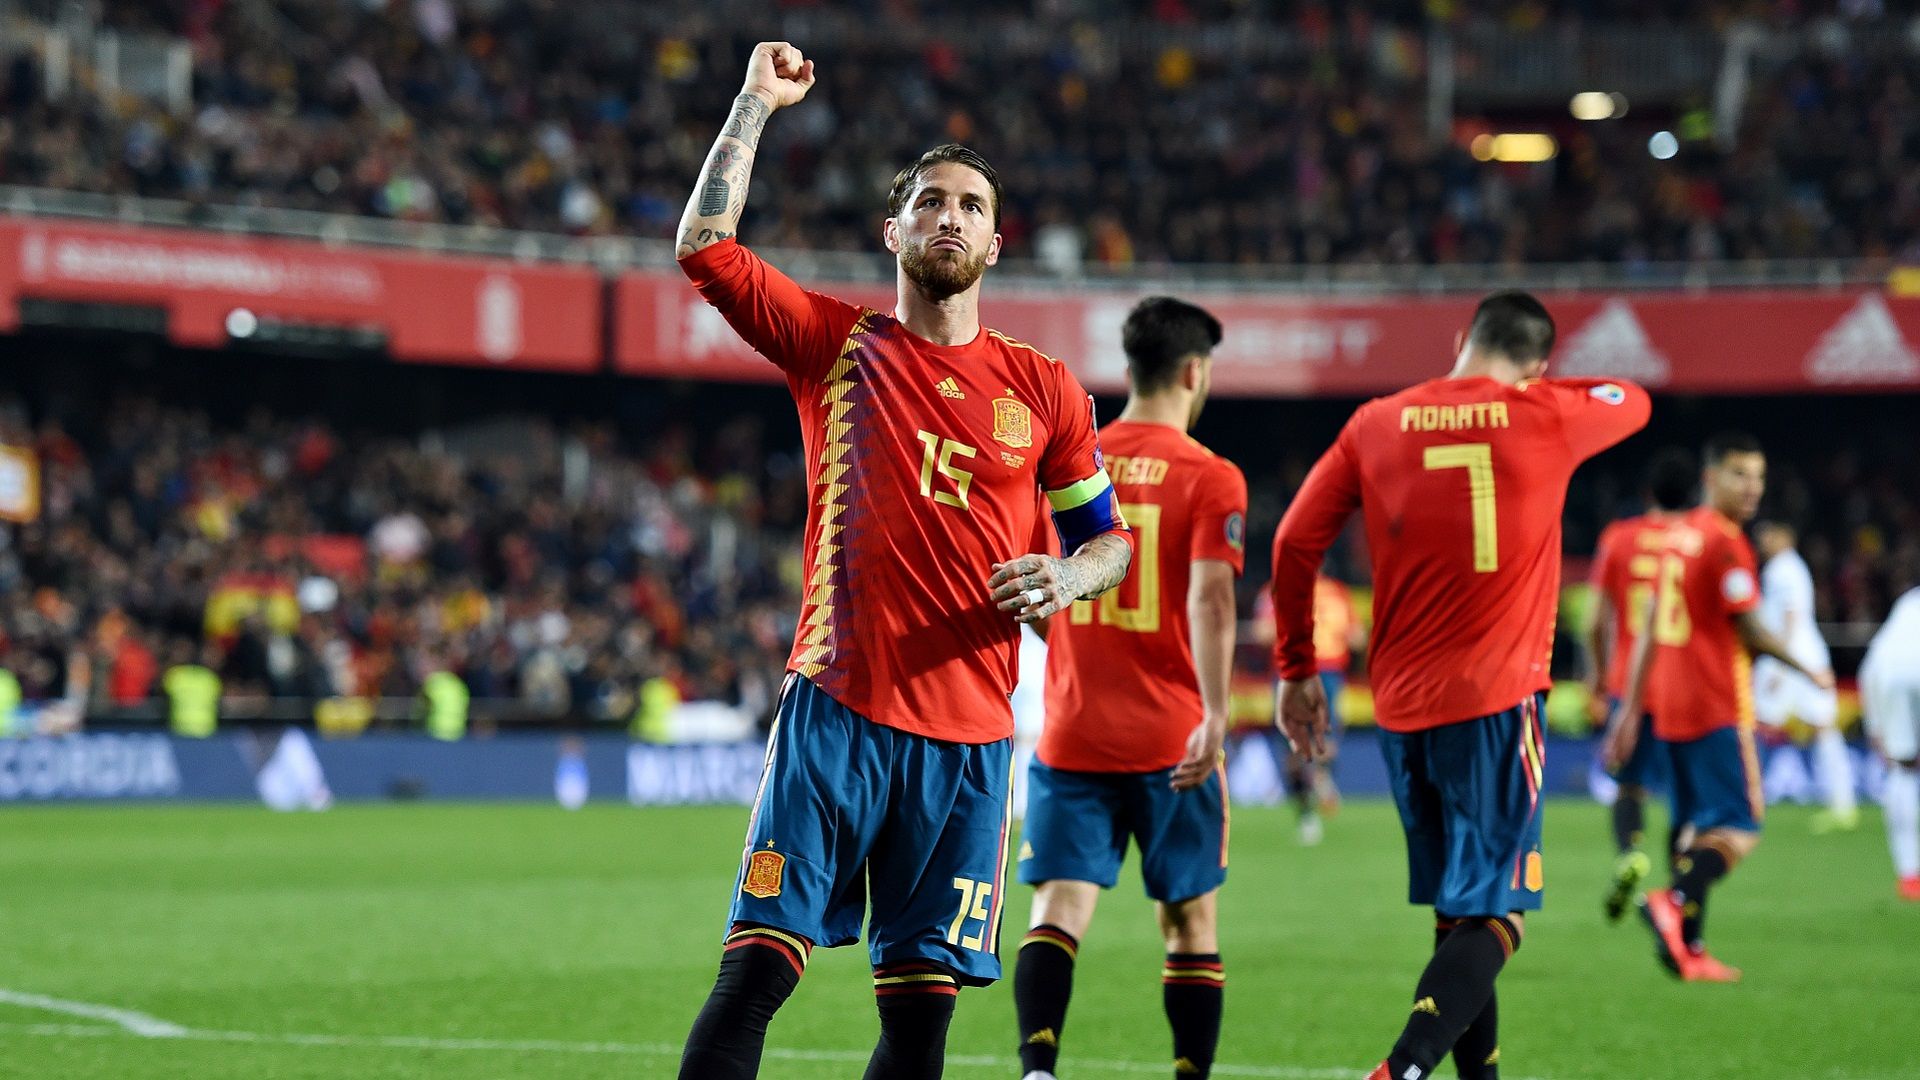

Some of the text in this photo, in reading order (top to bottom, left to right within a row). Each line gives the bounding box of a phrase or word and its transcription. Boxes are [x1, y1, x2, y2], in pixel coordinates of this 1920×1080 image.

[938, 388, 965, 400] didas
[1400, 401, 1509, 432] MORATA
[917, 429, 977, 511] 15
[1423, 443, 1498, 573] 7
[1070, 504, 1161, 633] 0
[948, 877, 993, 951] 15
